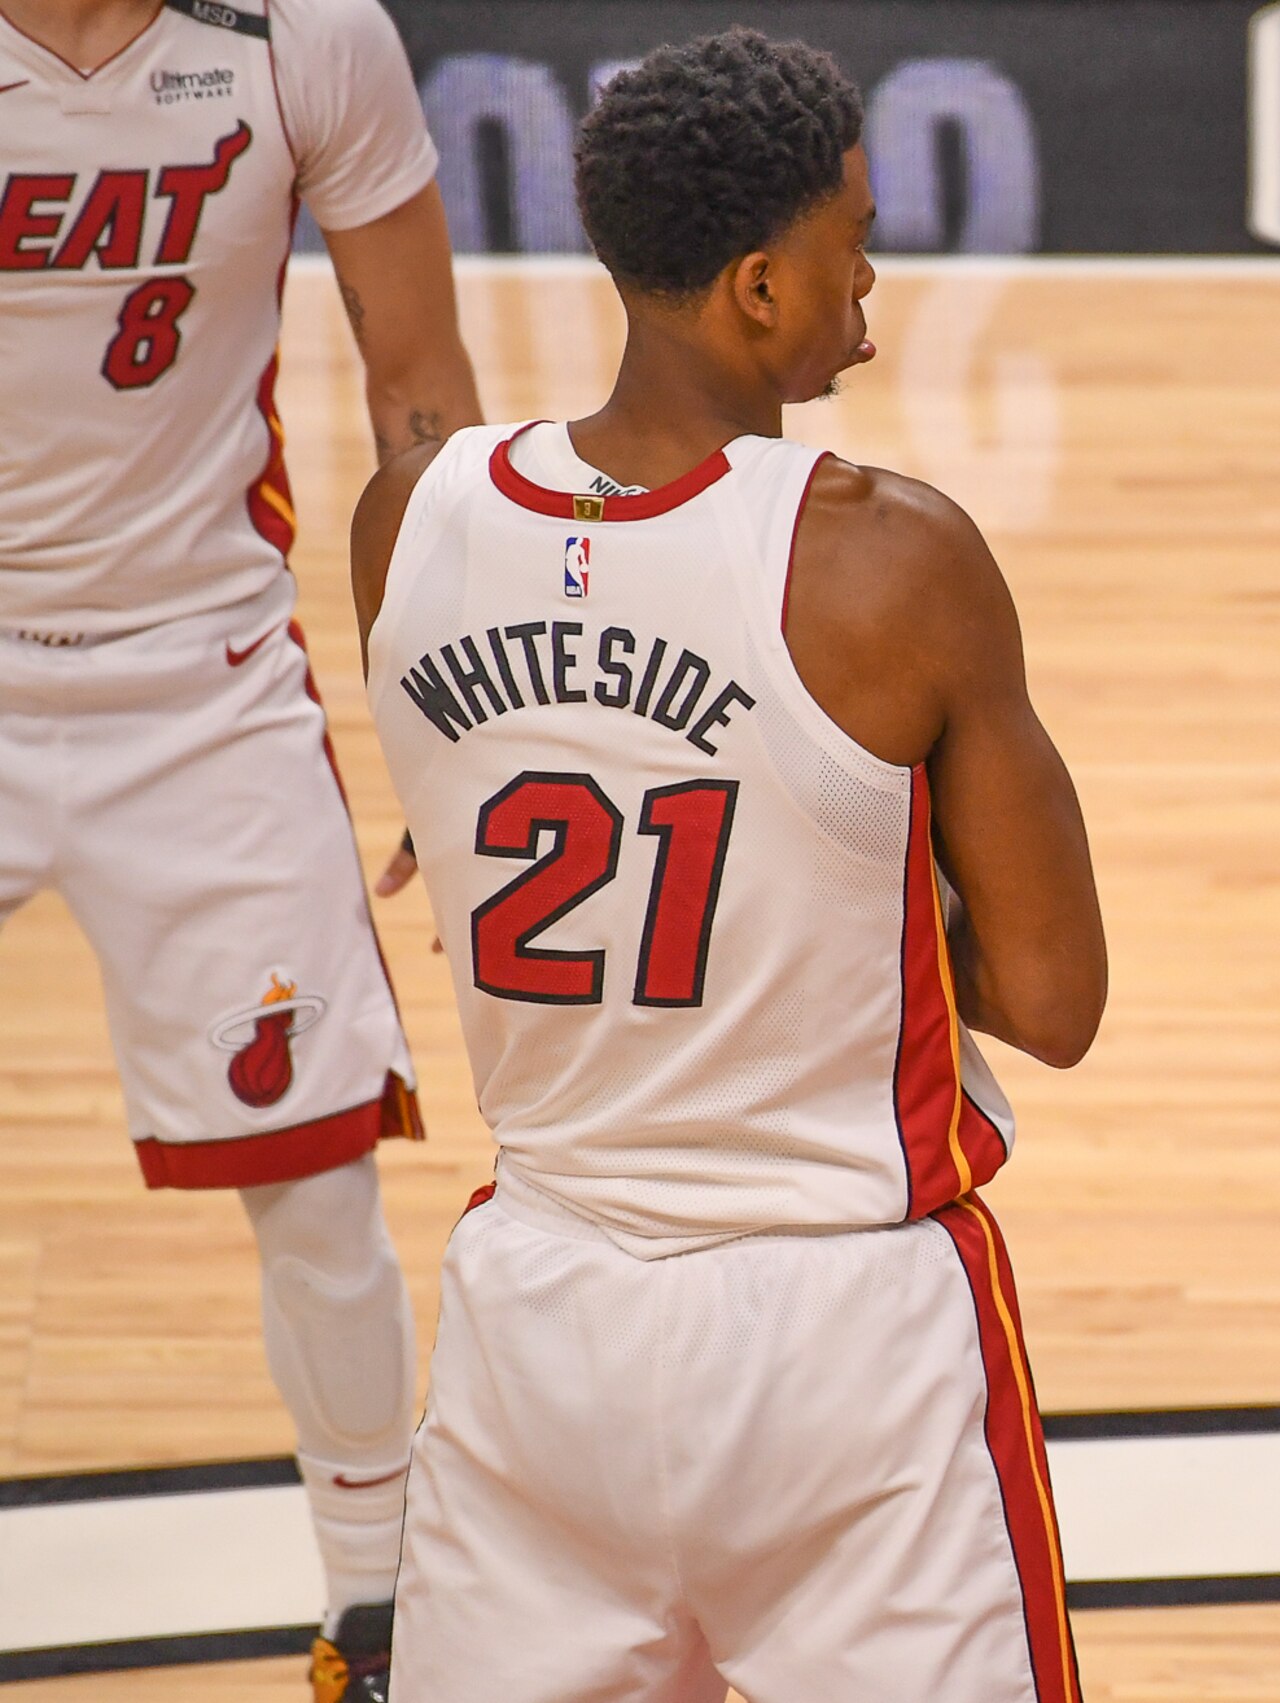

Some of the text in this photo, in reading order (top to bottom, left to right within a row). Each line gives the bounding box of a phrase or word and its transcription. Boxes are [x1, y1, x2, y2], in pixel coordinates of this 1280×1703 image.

[150, 69, 234, 93] Ultimate
[155, 87, 233, 105] SOFTWARE
[0, 118, 253, 271] EAT
[100, 275, 197, 393] 8
[400, 621, 757, 757] WHITESIDE
[470, 770, 741, 1008] 21
